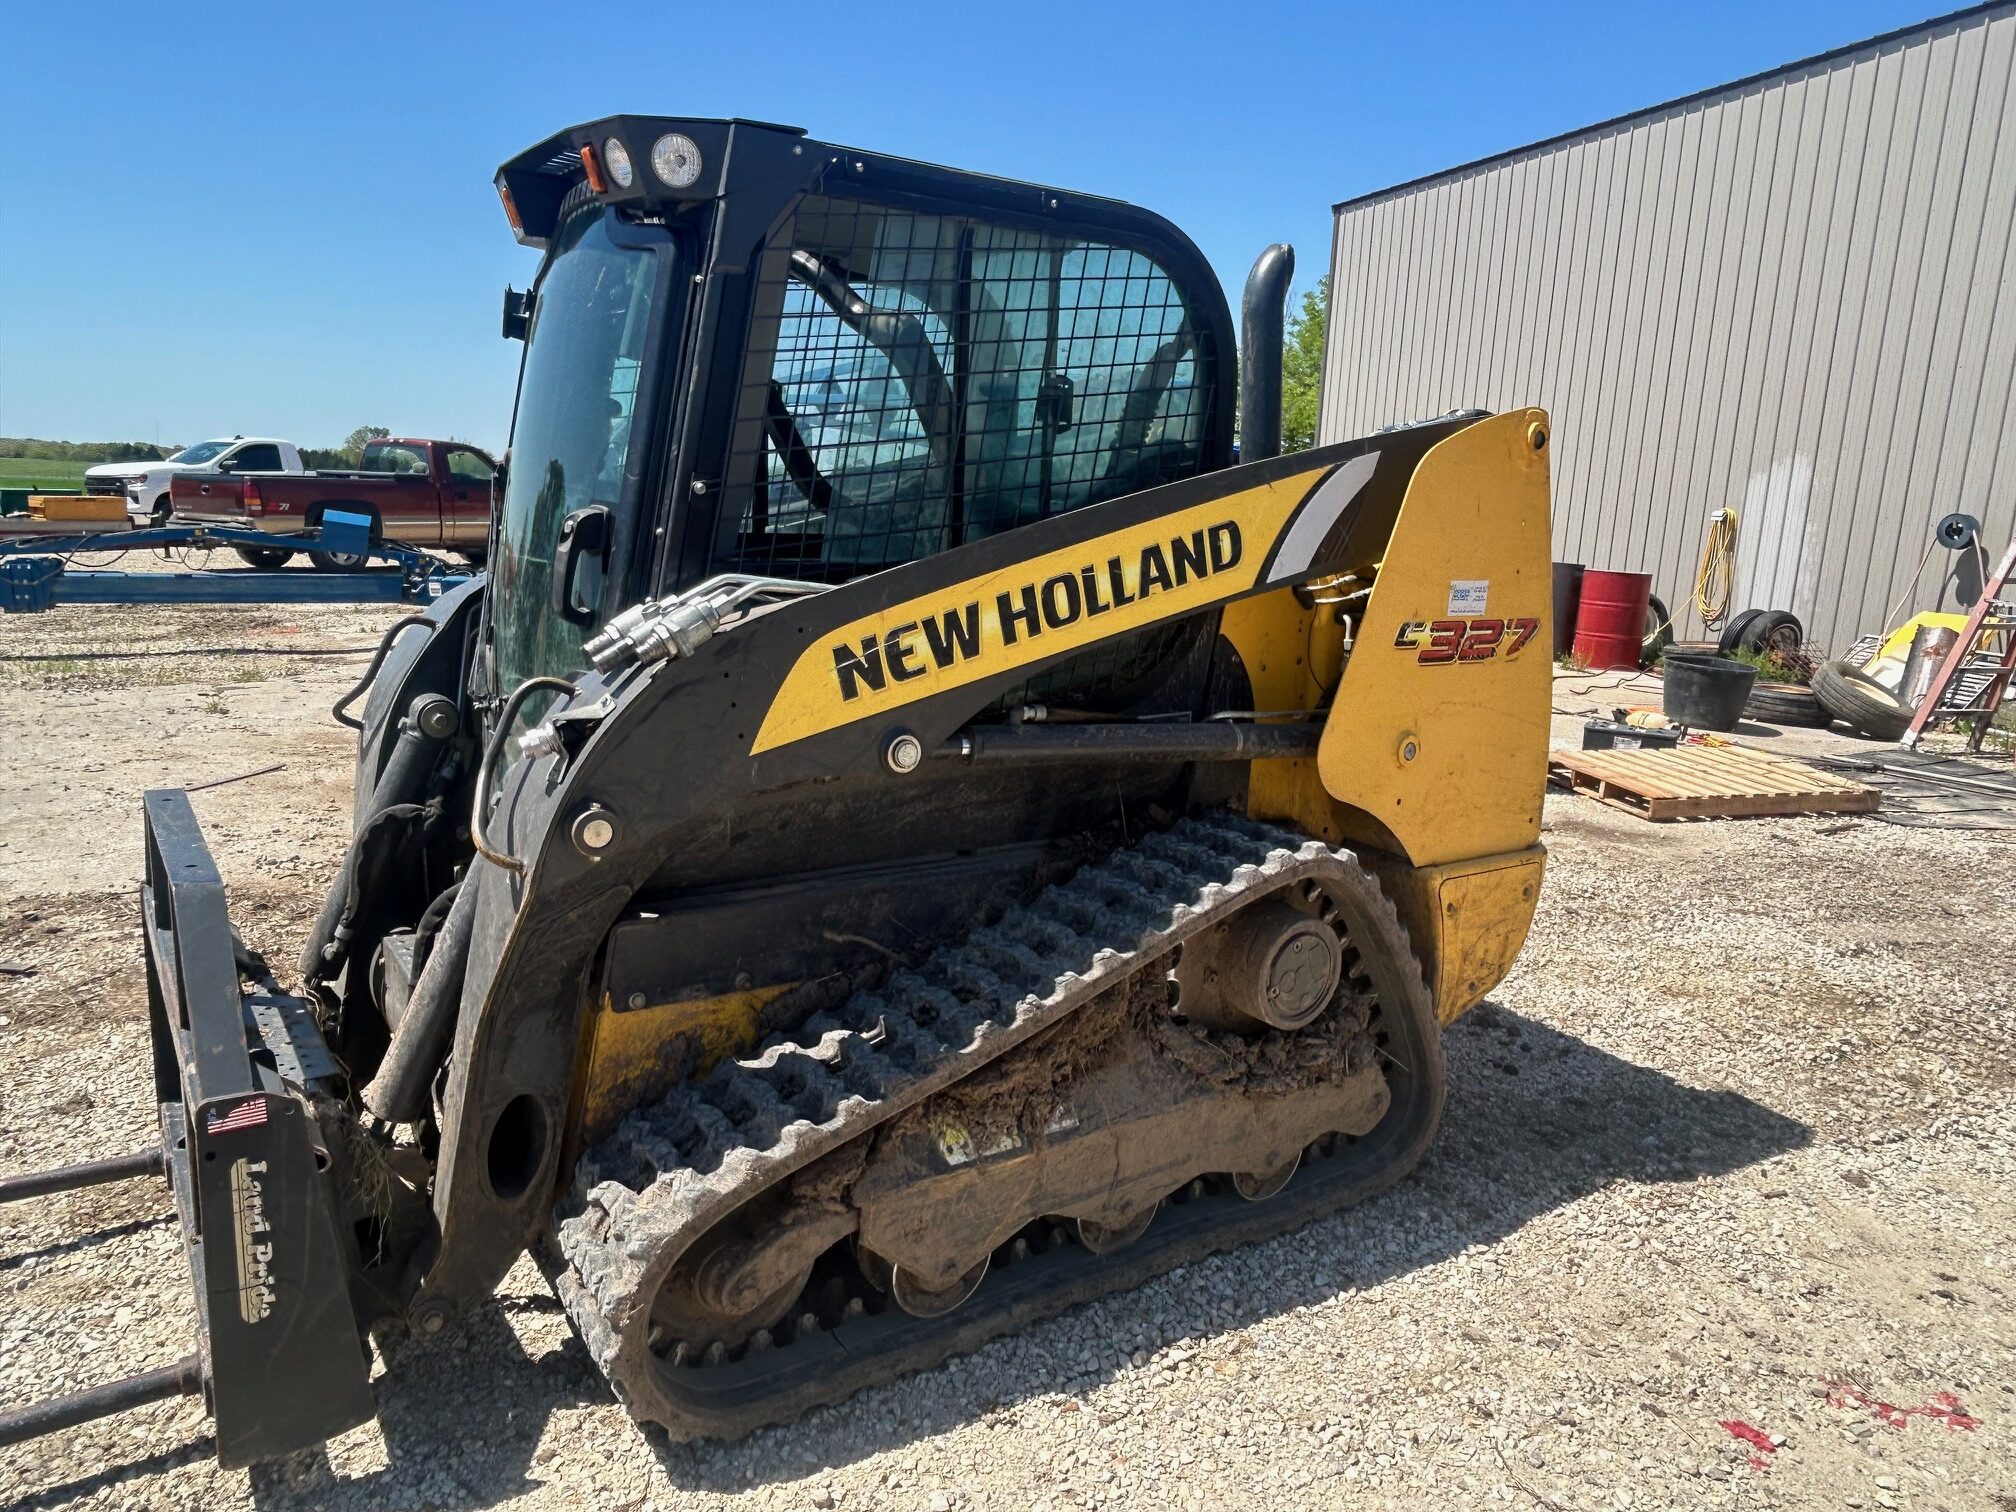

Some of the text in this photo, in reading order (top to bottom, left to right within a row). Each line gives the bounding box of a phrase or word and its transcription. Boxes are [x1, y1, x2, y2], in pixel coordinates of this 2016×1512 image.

[832, 519, 1243, 702] NEW HOLLAND
[1394, 618, 1541, 666] C327
[240, 1159, 277, 1320] Land Pride
